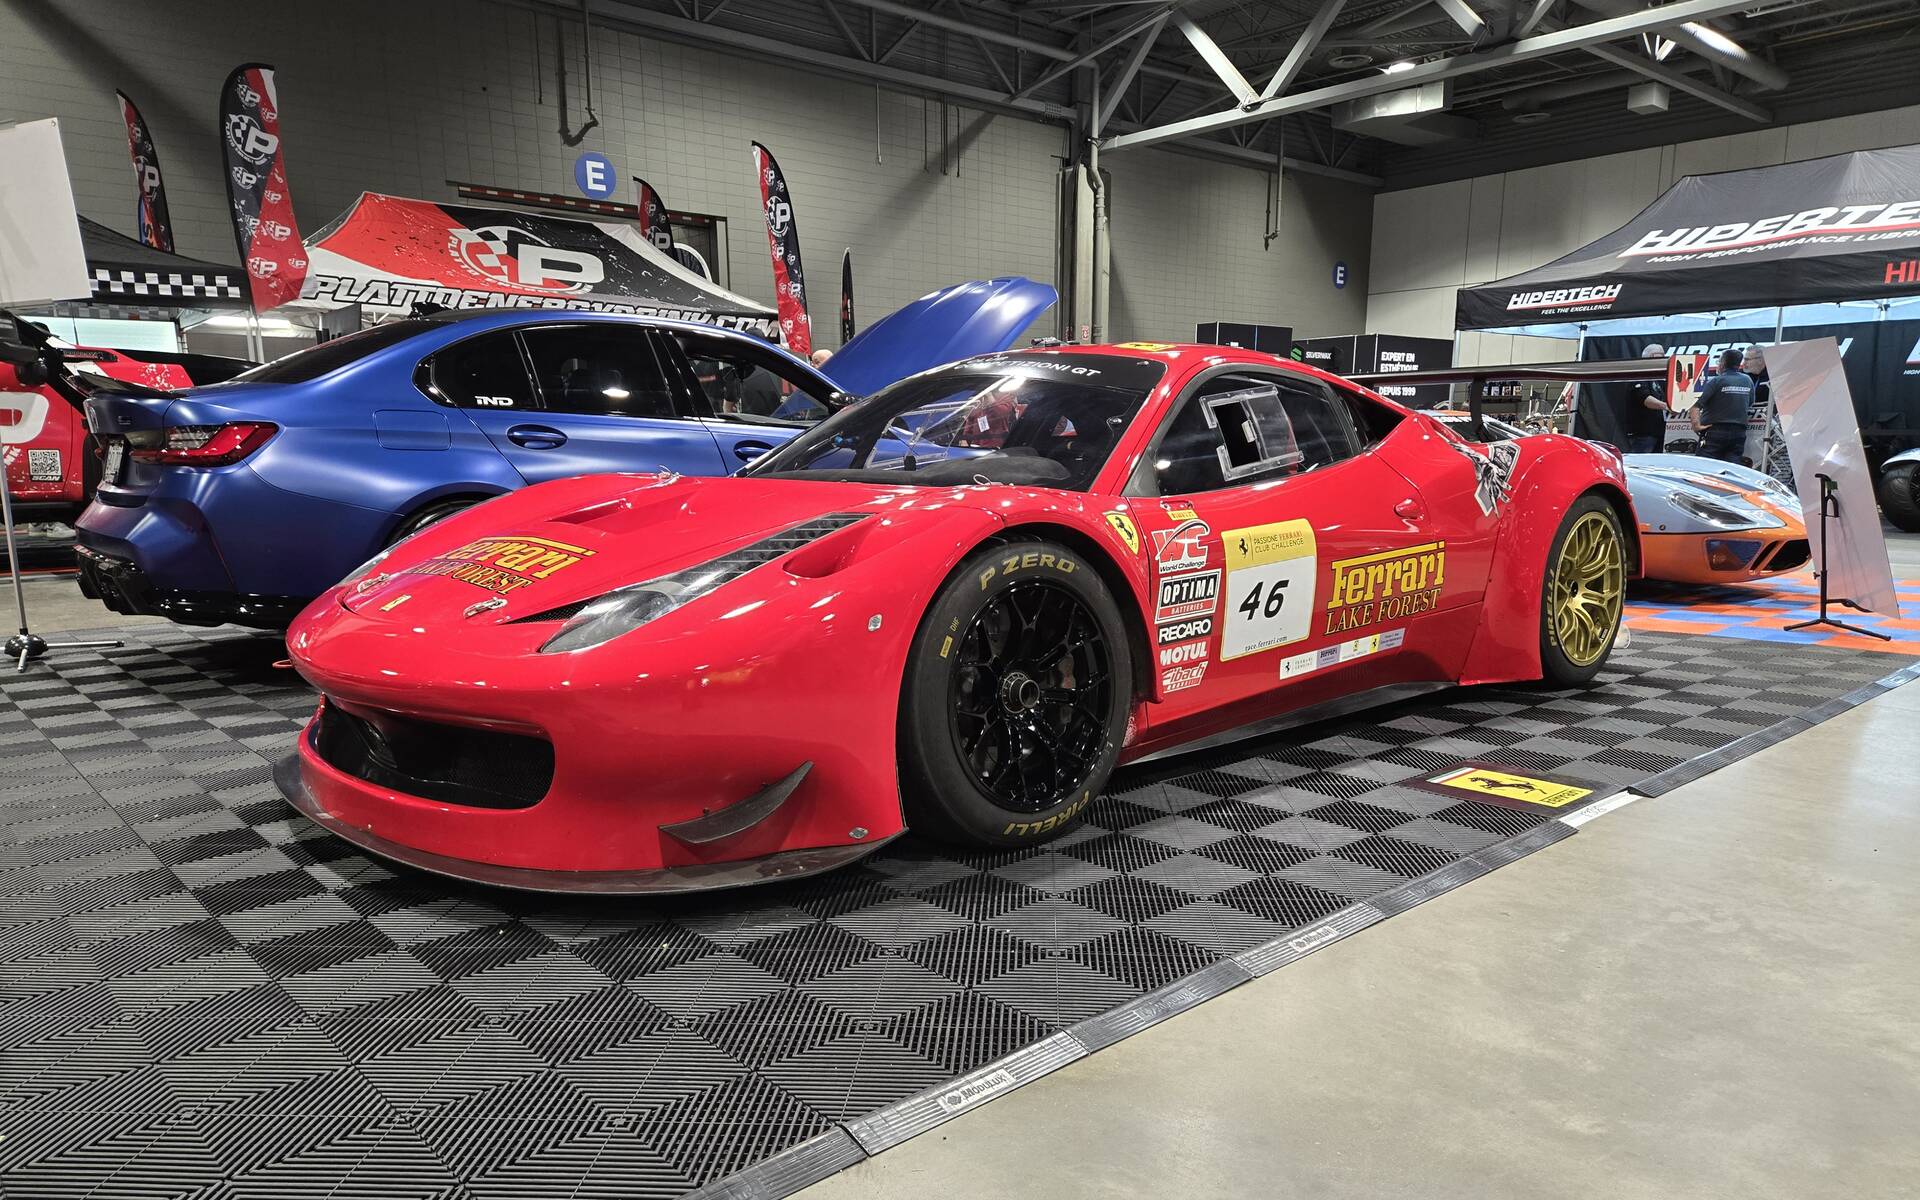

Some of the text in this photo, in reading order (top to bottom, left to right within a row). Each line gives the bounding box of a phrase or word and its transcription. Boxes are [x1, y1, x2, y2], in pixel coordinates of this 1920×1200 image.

[245, 126, 279, 154] P
[586, 160, 606, 191] E
[776, 203, 790, 229] P
[1696, 235, 1853, 259] PERFORMANCE
[518, 244, 604, 285] P
[1336, 266, 1344, 284] E
[1507, 283, 1622, 310] HIPERTECH
[1570, 303, 1613, 312] EXCELLENCE
[1381, 351, 1416, 363] EXPERT EN
[1379, 386, 1417, 396] DEPUIS 1999
[1253, 530, 1302, 546] PASSIONE FERRARI
[1255, 538, 1304, 553] CLUB CHALLENGE
[431, 536, 599, 580] Ferrari
[980, 553, 1077, 591] P ZERO
[1326, 540, 1446, 610] Ferrari
[1163, 579, 1215, 604] OPTIMA
[1239, 579, 1290, 621] 46
[1171, 602, 1204, 614] BATTERIES
[1324, 588, 1441, 635] LAKE FOREST
[1159, 618, 1211, 643] RECARO
[1160, 641, 1207, 666] MOTUL
